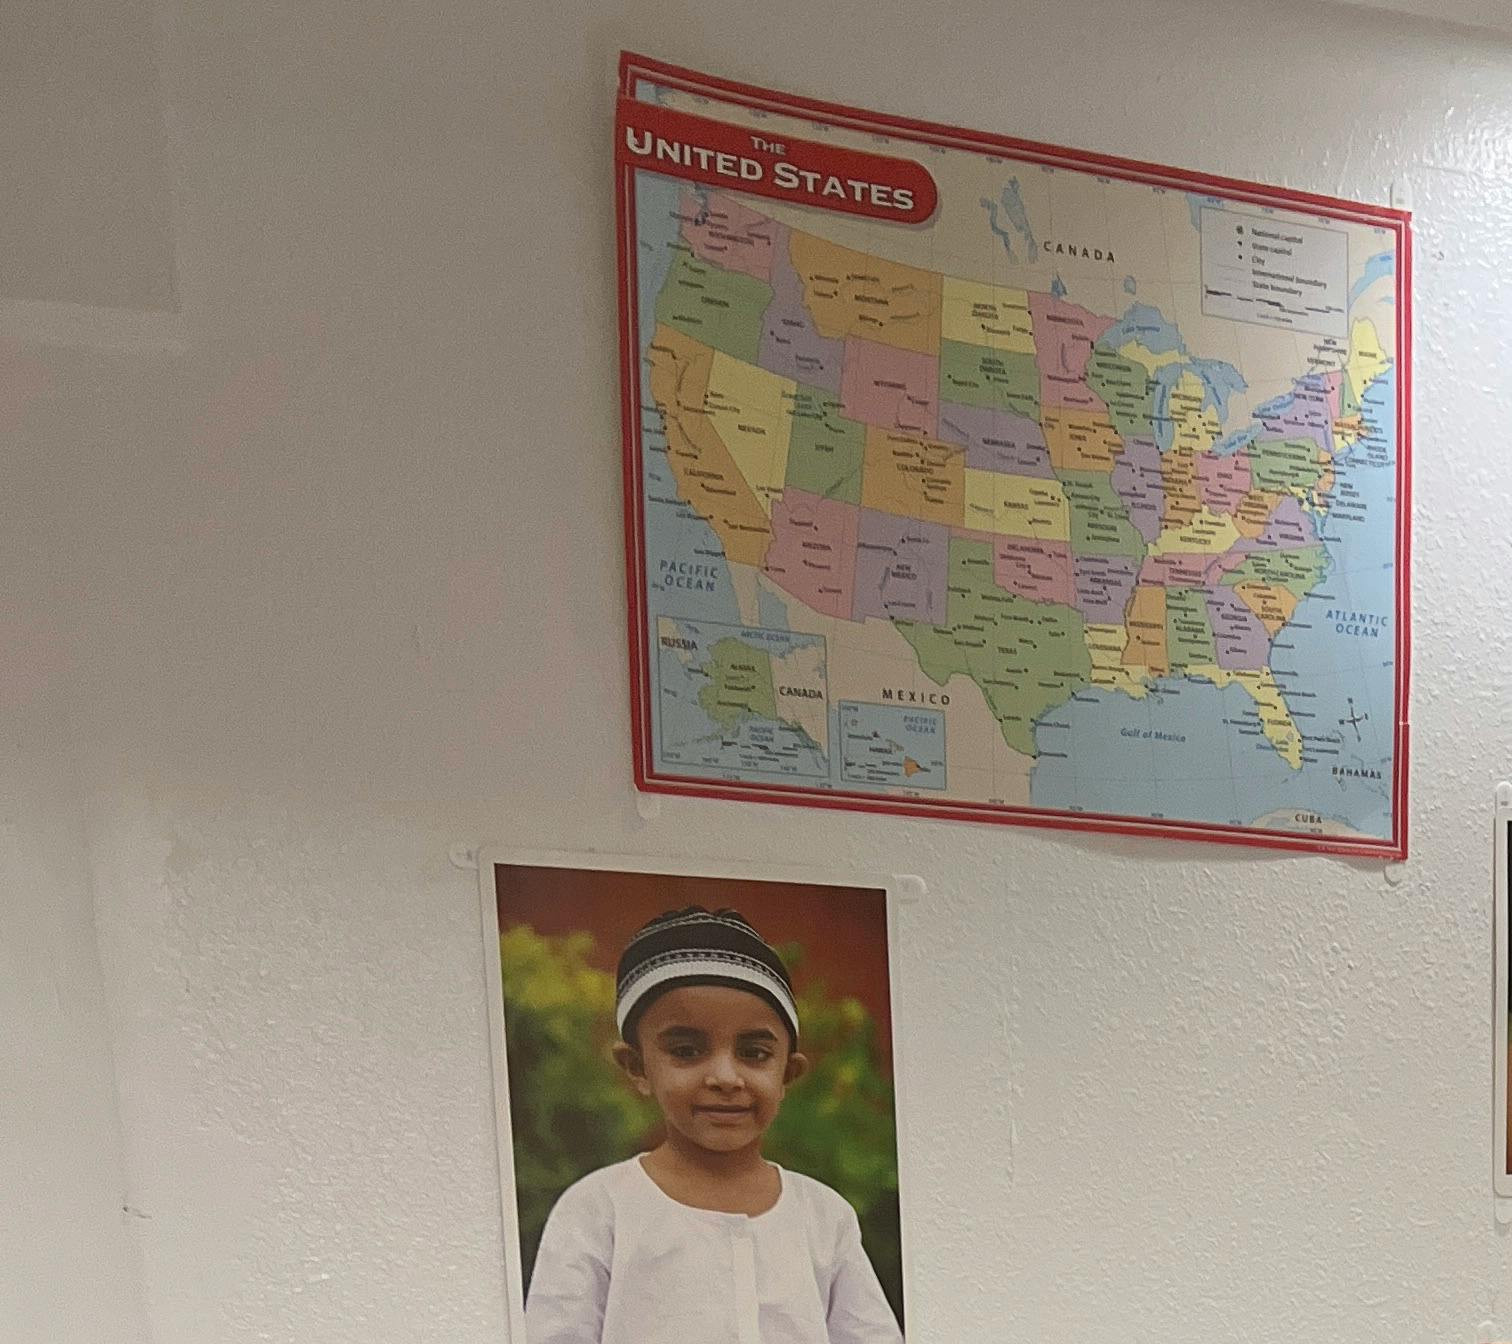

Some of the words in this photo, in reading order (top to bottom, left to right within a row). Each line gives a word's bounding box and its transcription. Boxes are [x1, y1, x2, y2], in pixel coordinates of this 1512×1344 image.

[750, 135, 787, 155] THE
[626, 127, 763, 180] UNITED
[774, 163, 914, 211] STATES
[1043, 241, 1115, 263] CANADA
[660, 560, 718, 577] PACIFIC
[664, 576, 715, 592] OCEAN
[1325, 610, 1389, 627] ATLANTIC
[1335, 624, 1379, 638] OCEAN
[661, 636, 698, 651] RUSSIA
[778, 686, 823, 700] CANADA
[882, 688, 950, 705] MEXICO
[1120, 727, 1140, 739] Gulf
[1143, 730, 1152, 740] of
[1154, 731, 1186, 743] Mexico
[1332, 766, 1382, 781] BAHAMAS
[1295, 813, 1323, 824] CUBA
